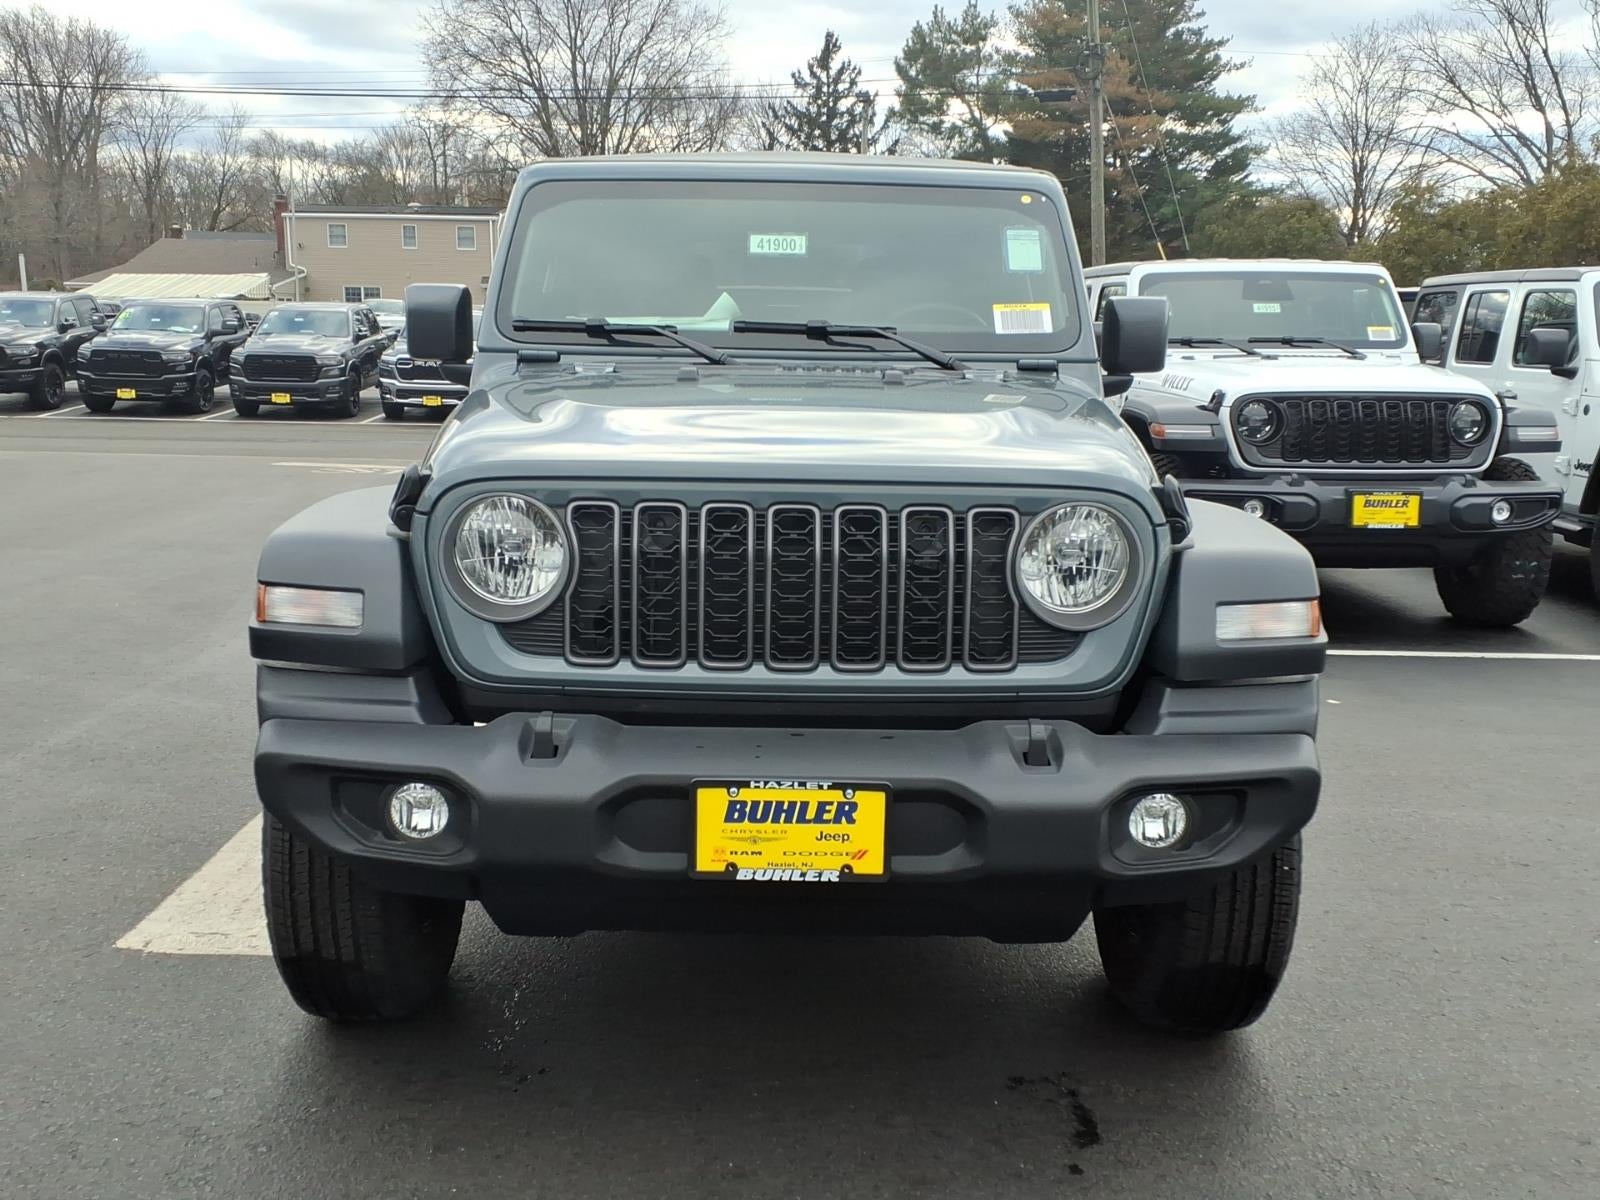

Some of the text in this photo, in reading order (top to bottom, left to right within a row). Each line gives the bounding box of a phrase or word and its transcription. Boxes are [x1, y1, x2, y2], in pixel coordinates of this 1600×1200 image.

[757, 238, 797, 251] 41900
[1161, 374, 1195, 391] WILLYS
[1363, 499, 1410, 509] BUHLER
[749, 781, 833, 790] HAZLET
[723, 799, 859, 825] BUHLER
[815, 830, 850, 844] Jeep
[736, 868, 840, 883] BUHLER
